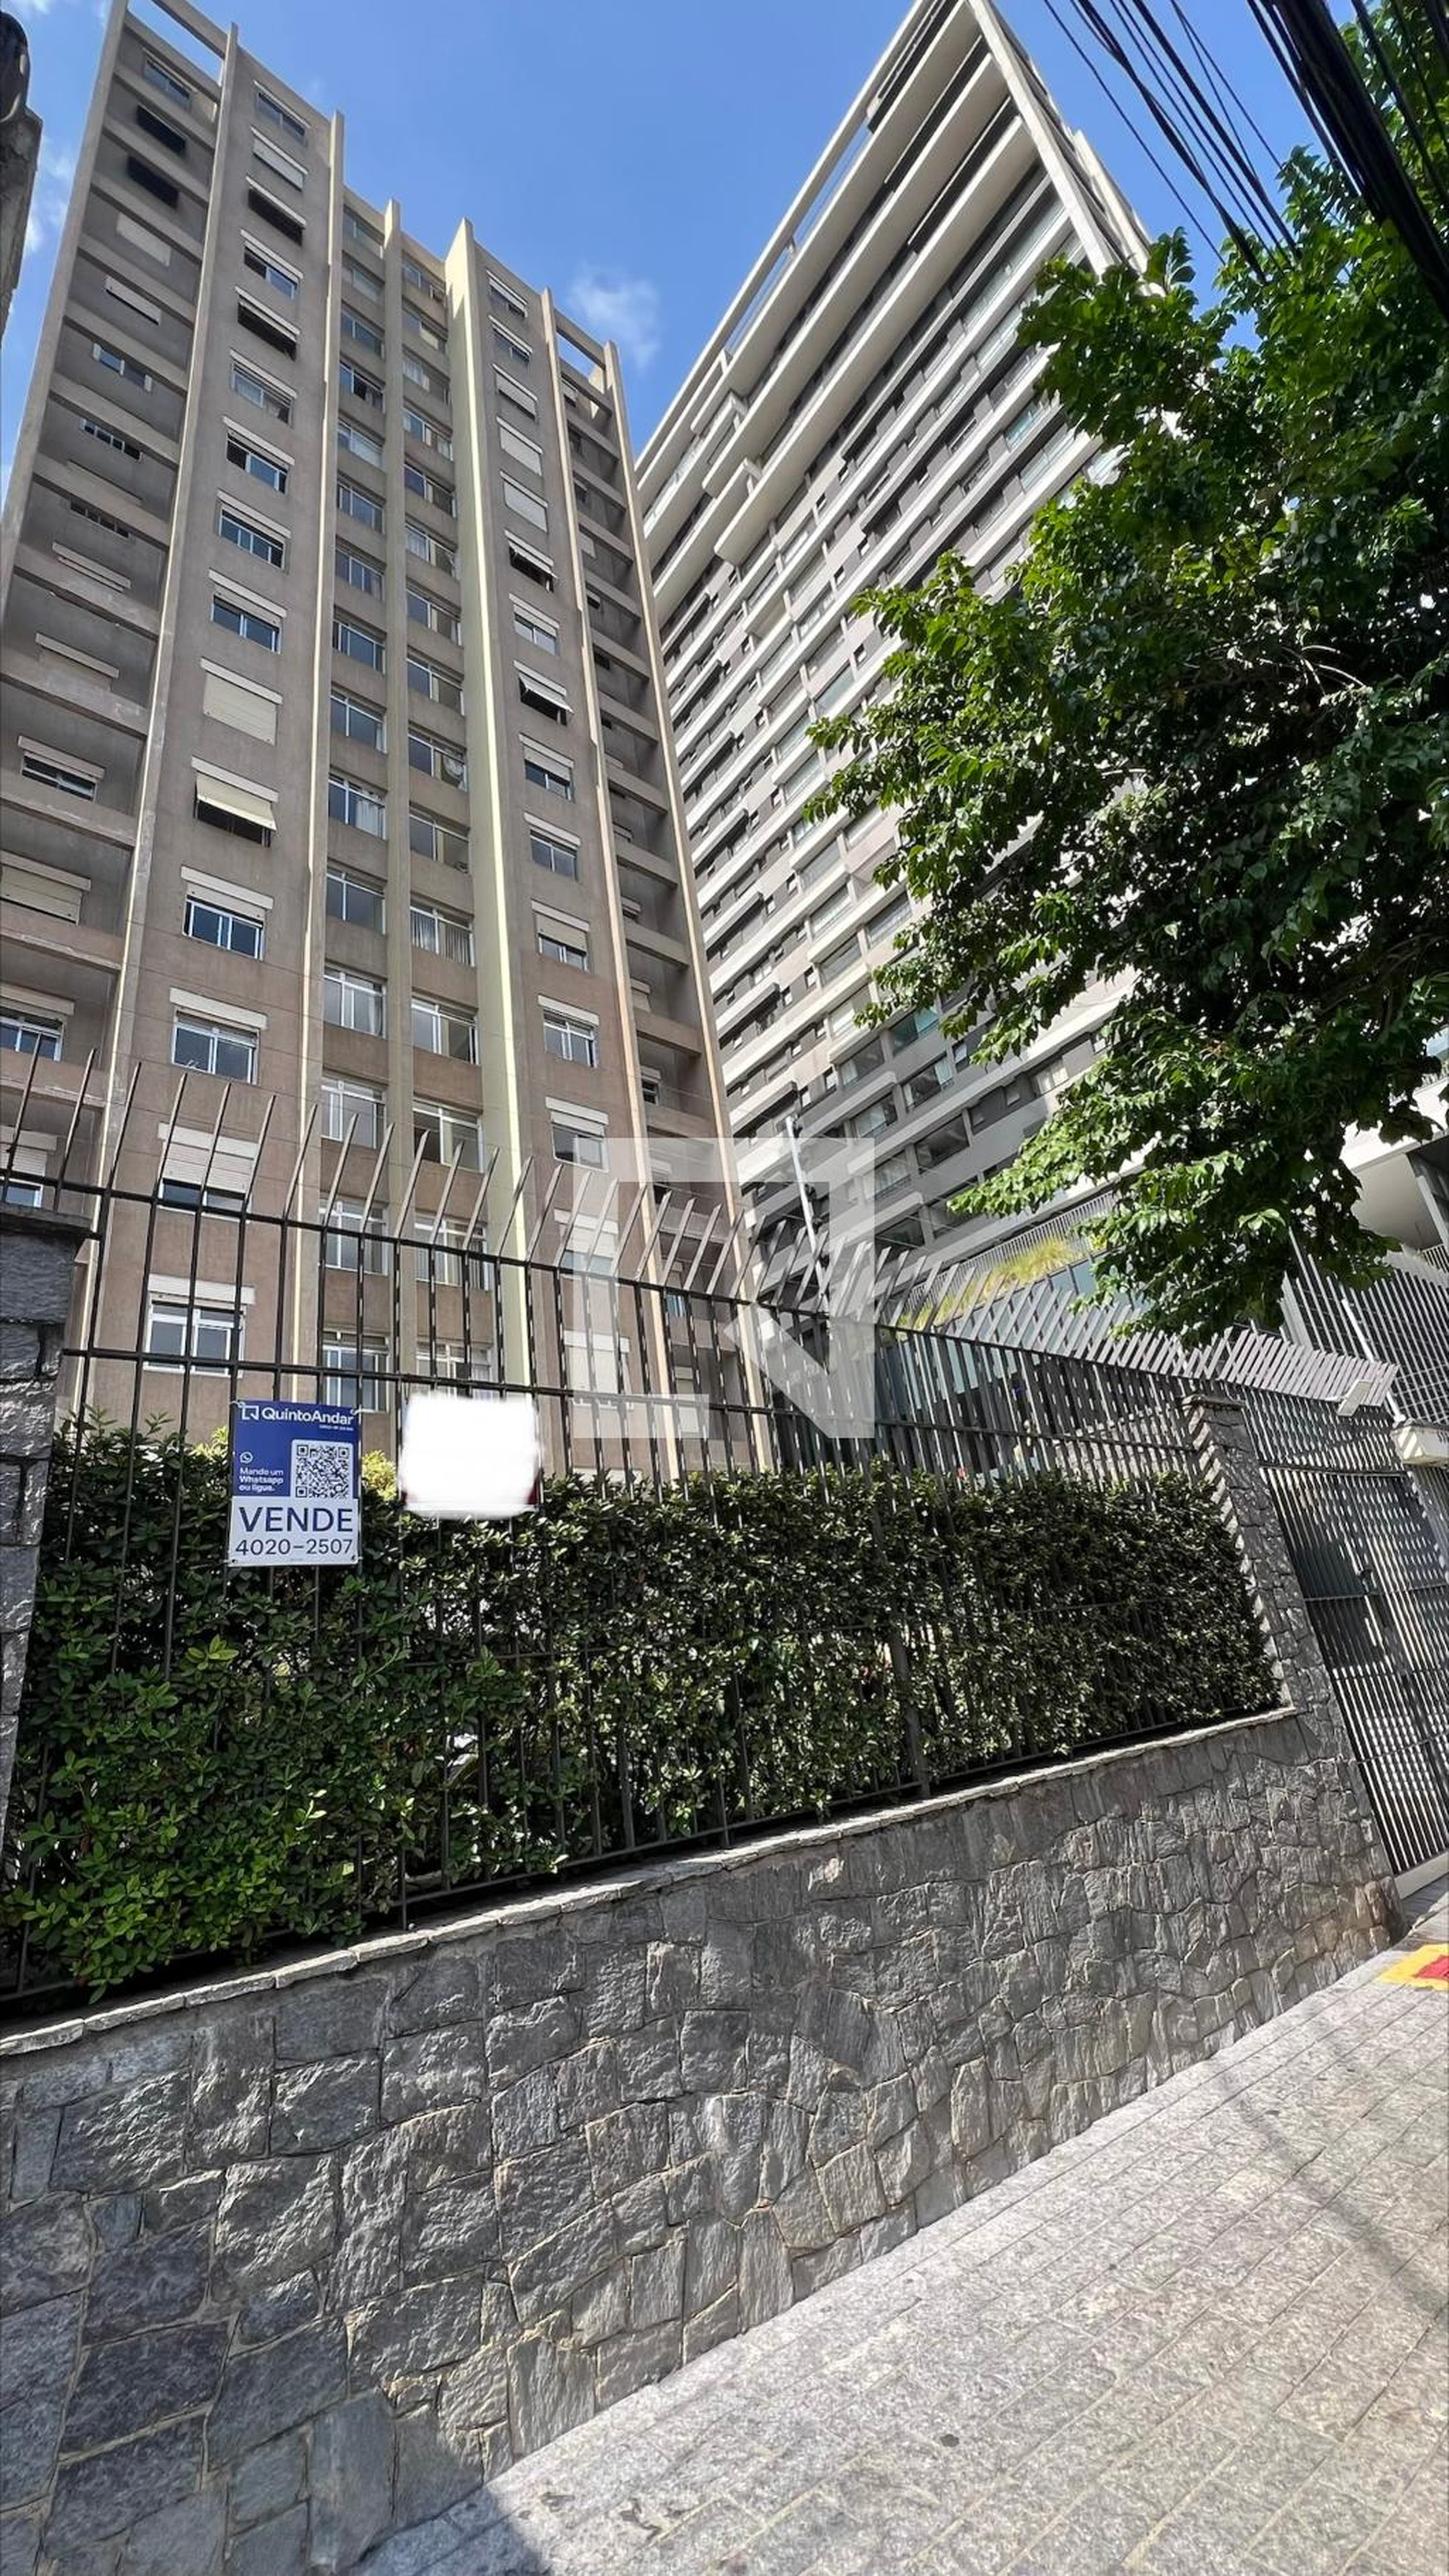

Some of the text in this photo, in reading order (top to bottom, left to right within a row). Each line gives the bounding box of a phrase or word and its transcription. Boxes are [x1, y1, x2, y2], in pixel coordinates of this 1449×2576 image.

[261, 1407, 354, 1425] QuintoAndar
[239, 1507, 353, 1532] VENDE
[236, 1538, 353, 1555] 4020-2507
